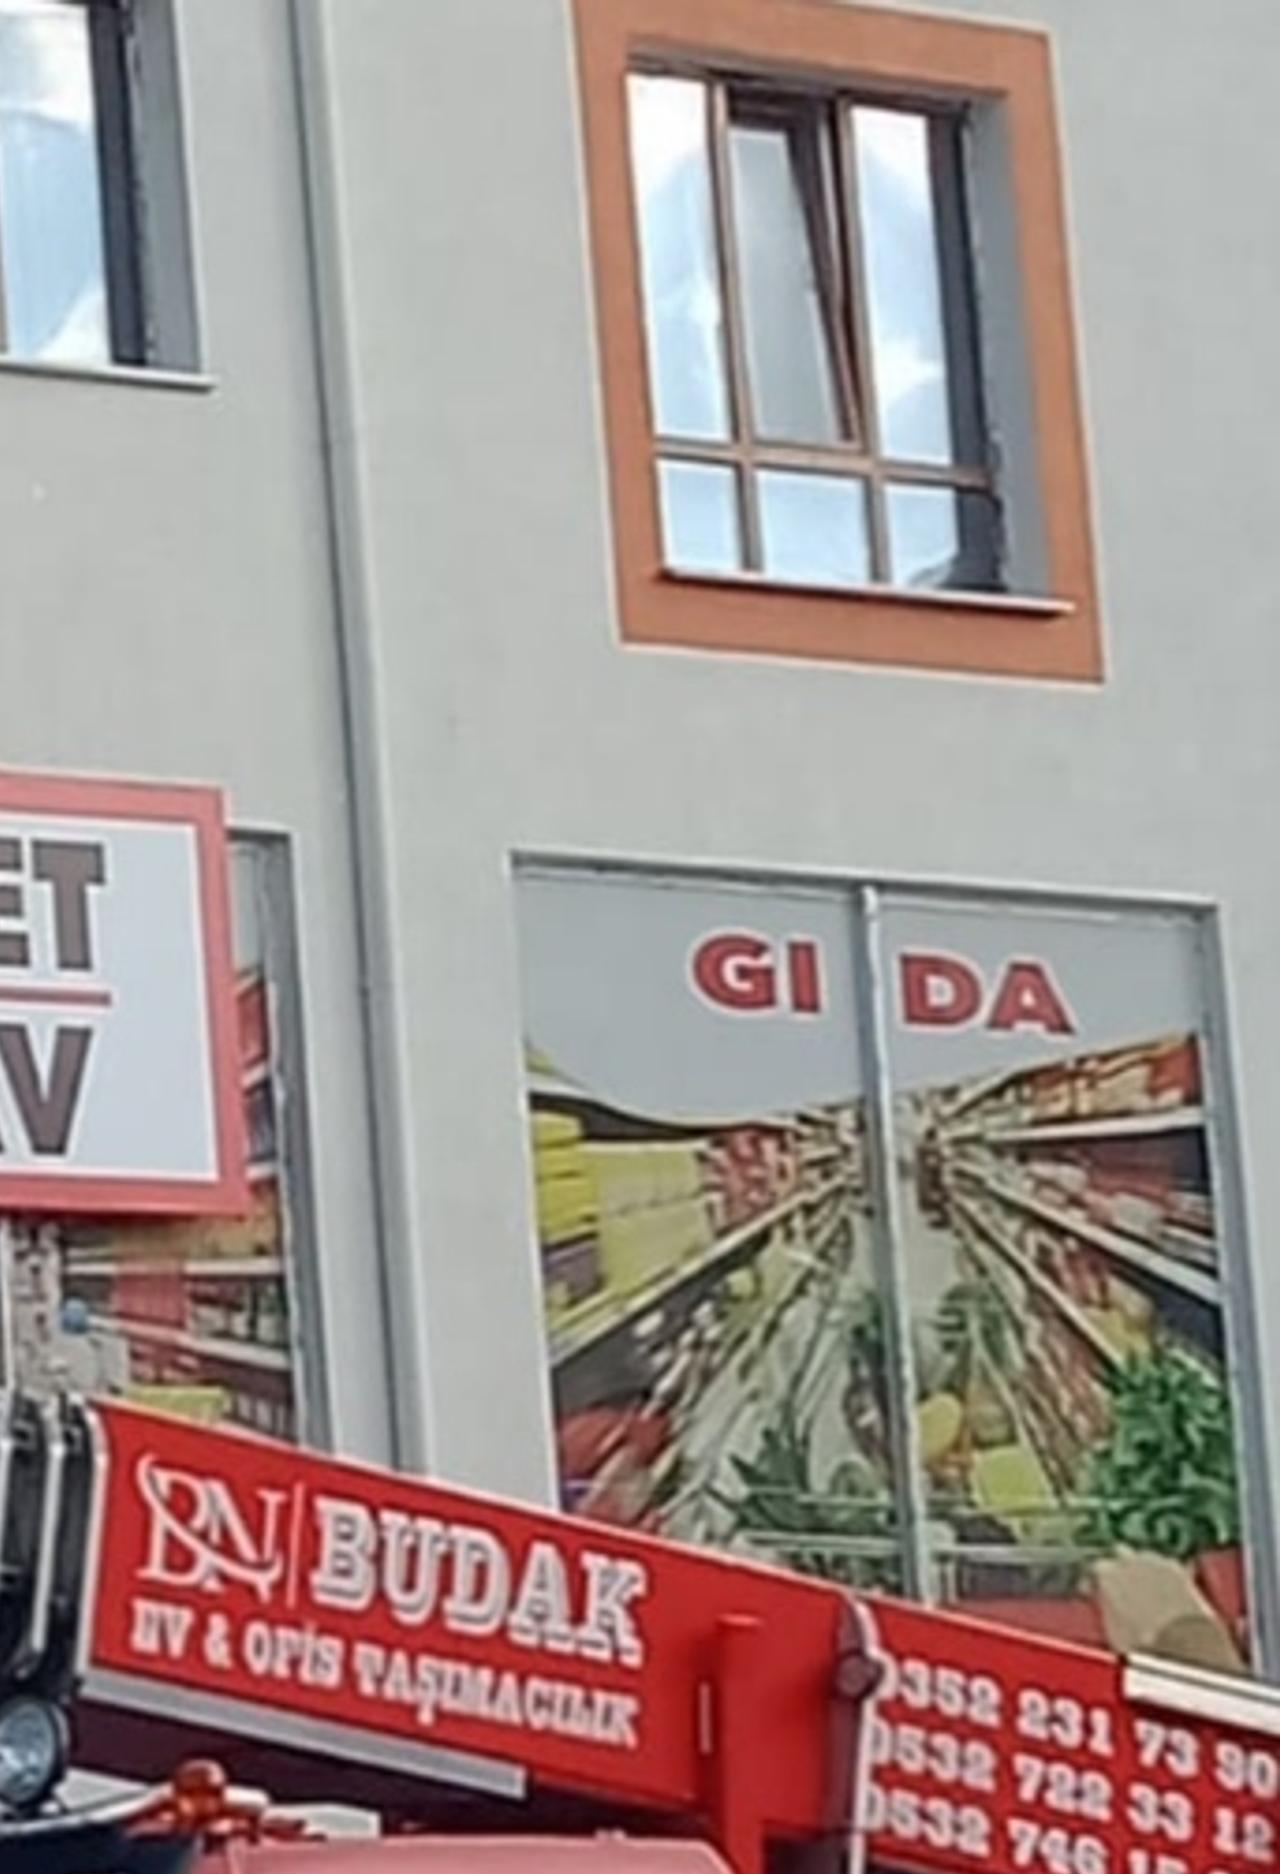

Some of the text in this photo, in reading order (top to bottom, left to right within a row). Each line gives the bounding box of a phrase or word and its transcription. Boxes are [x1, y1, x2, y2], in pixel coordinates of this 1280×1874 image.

[311, 1496, 647, 1668] BUDAK
[203, 1614, 232, 1668] &
[1017, 1688, 1115, 1756] 231
[1135, 1719, 1199, 1777] 73
[1013, 1753, 1111, 1821] 722
[1127, 1783, 1194, 1840] 33
[1213, 1806, 1273, 1862] 12
